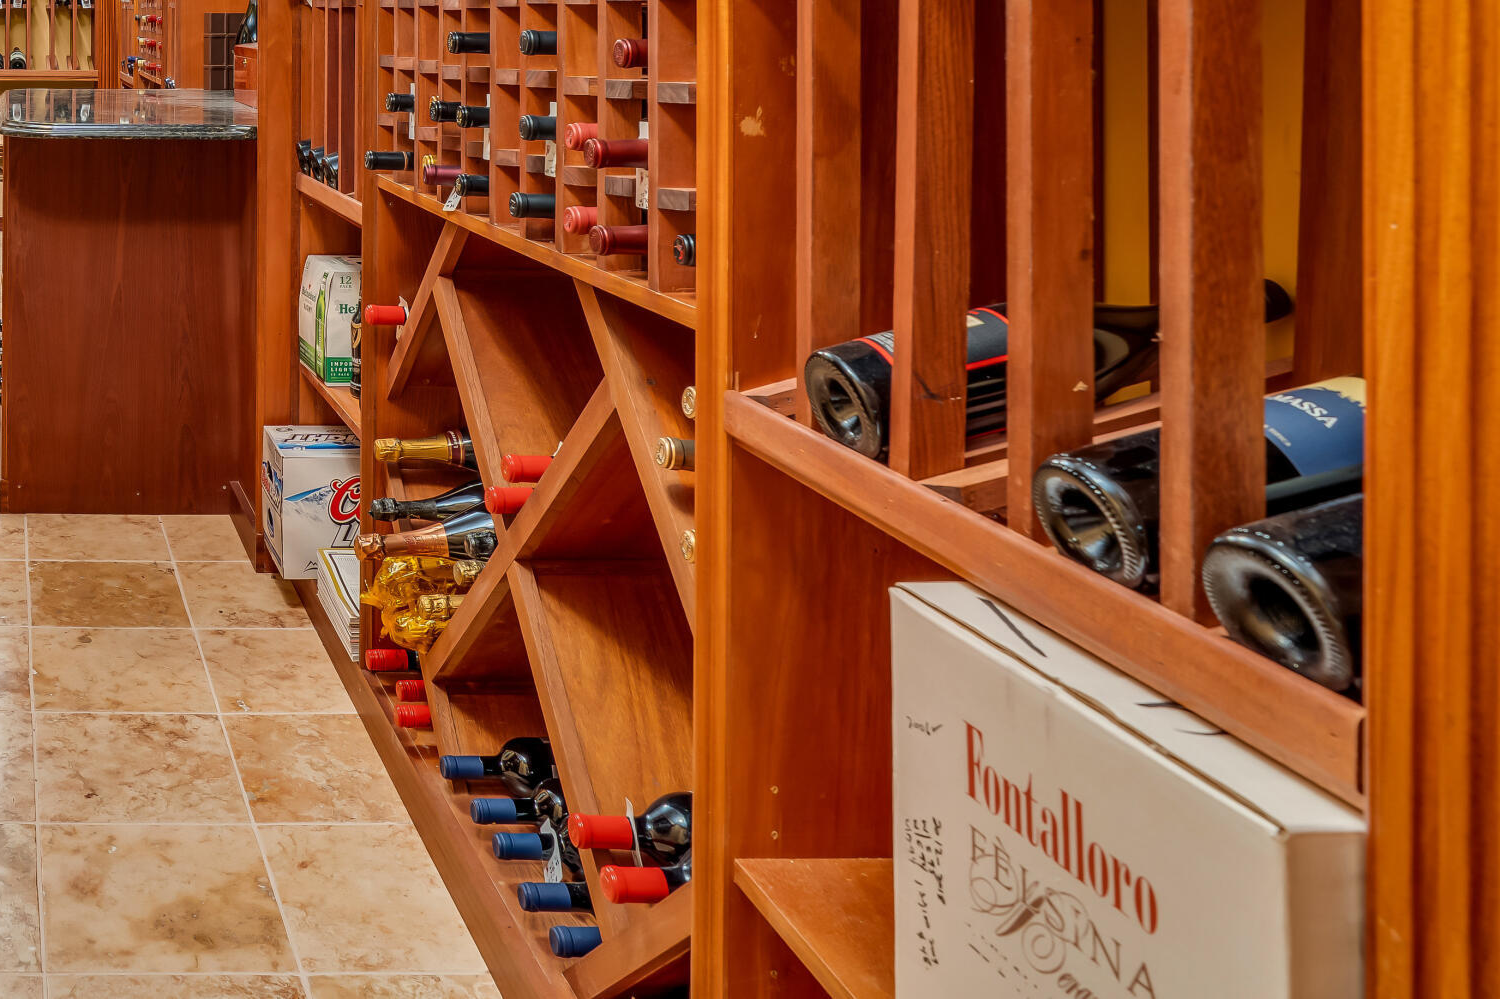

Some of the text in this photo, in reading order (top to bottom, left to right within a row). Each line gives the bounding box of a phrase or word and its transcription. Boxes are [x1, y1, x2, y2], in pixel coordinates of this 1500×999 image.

[340, 275, 352, 285] 12
[339, 303, 360, 315] Hei
[962, 719, 1159, 935] Fontalloro
